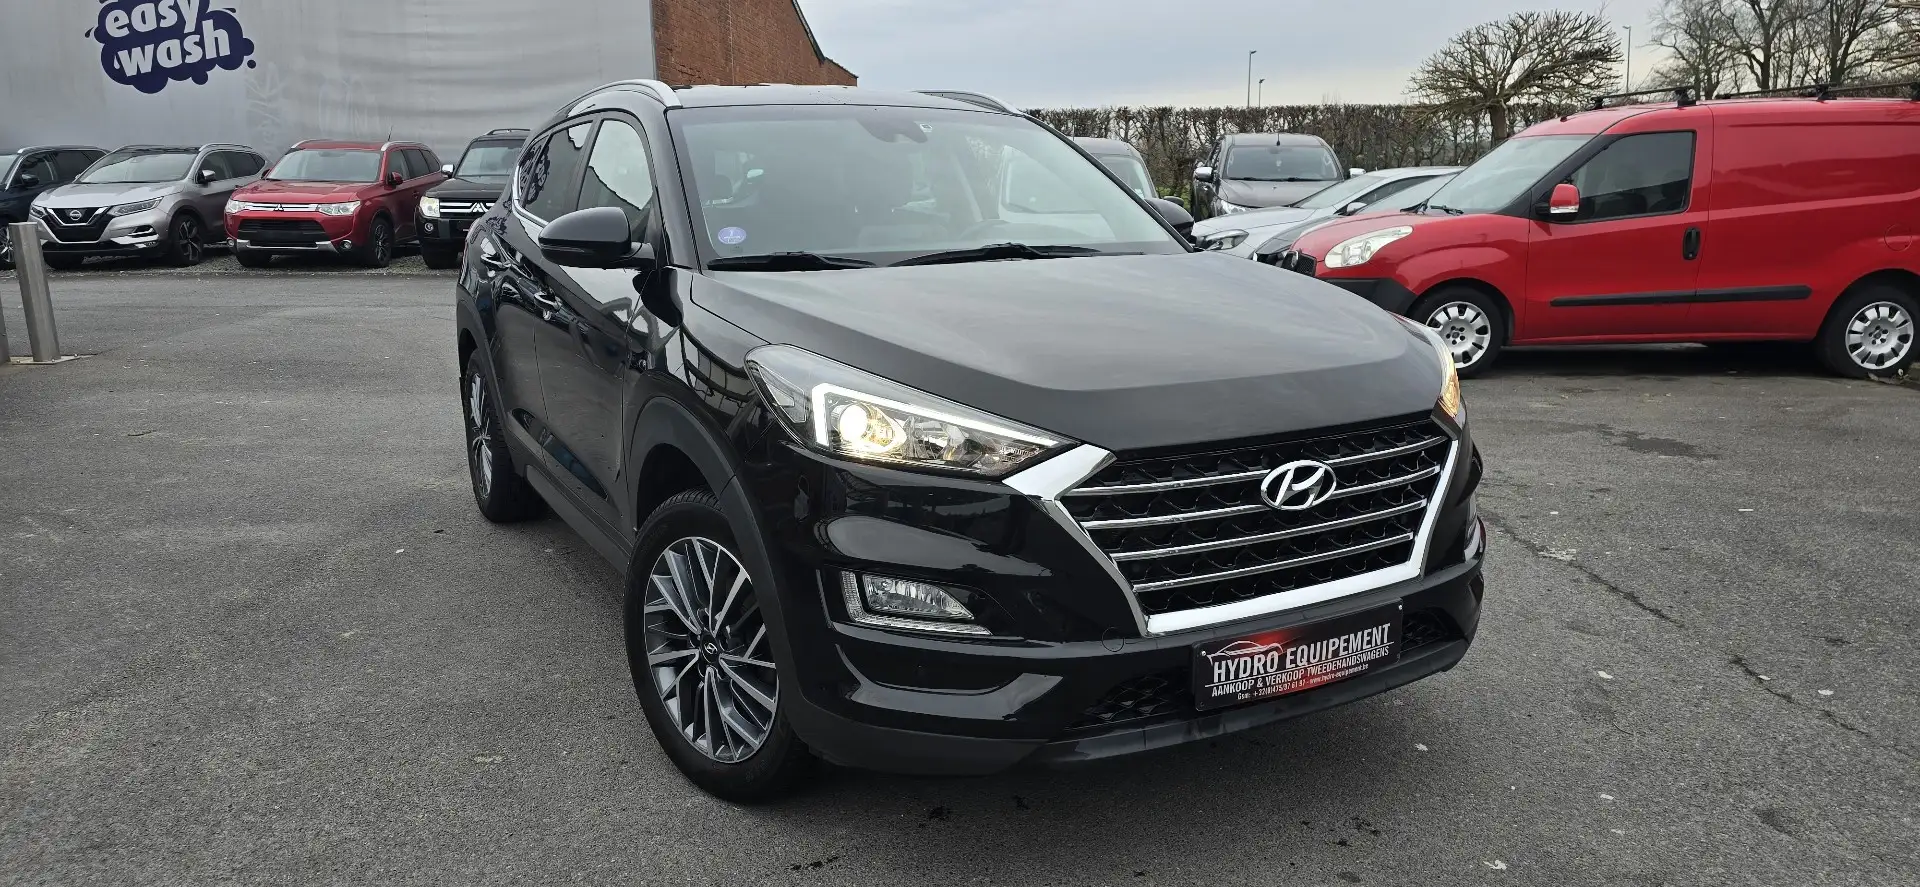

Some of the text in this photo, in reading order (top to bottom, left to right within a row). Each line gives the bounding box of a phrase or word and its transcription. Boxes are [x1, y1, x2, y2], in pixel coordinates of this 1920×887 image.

[105, 0, 199, 37] easy
[117, 19, 231, 77] wash
[1211, 647, 1390, 697] AANKOOP & VERKOOP TWEEDEHANDSWAGENS
[1213, 623, 1391, 683] HYDRO EQUIPEMENT
